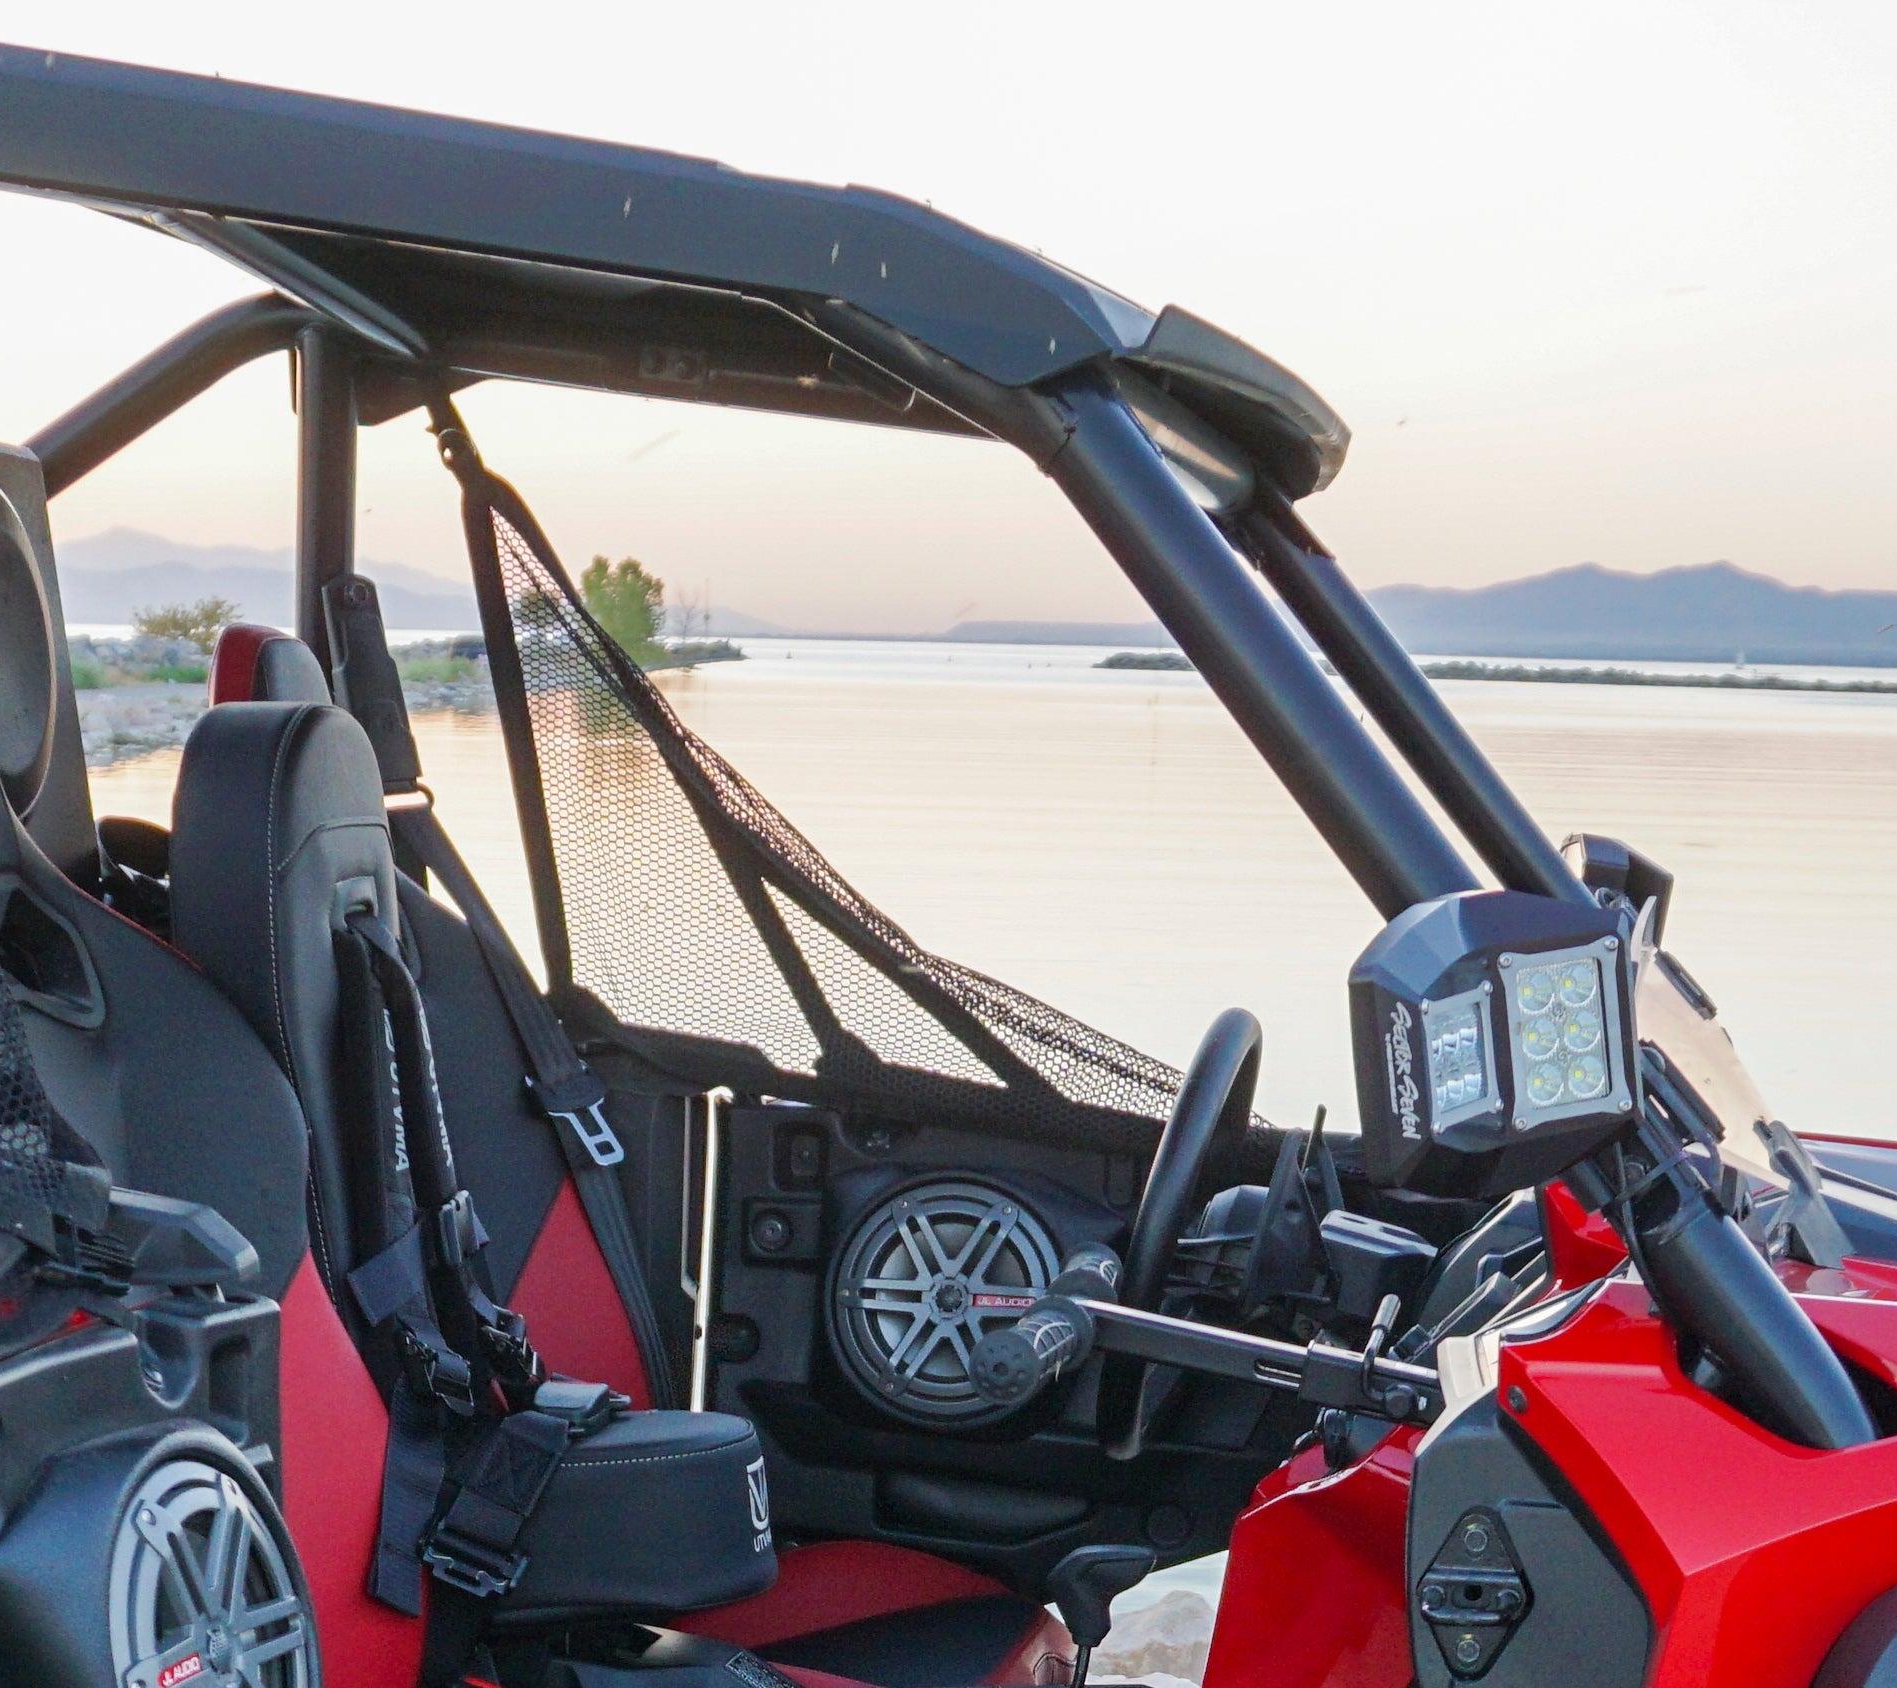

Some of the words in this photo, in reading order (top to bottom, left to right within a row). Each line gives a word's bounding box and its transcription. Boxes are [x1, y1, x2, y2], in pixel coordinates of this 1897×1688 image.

[1390, 1001, 1412, 1076] SECTOR
[1397, 1074, 1421, 1140] SEVEN
[977, 1296, 991, 1305] JL
[995, 1297, 1032, 1307] AUDIO
[162, 1671, 174, 1687] JL
[173, 1656, 201, 1681] AUDIO
